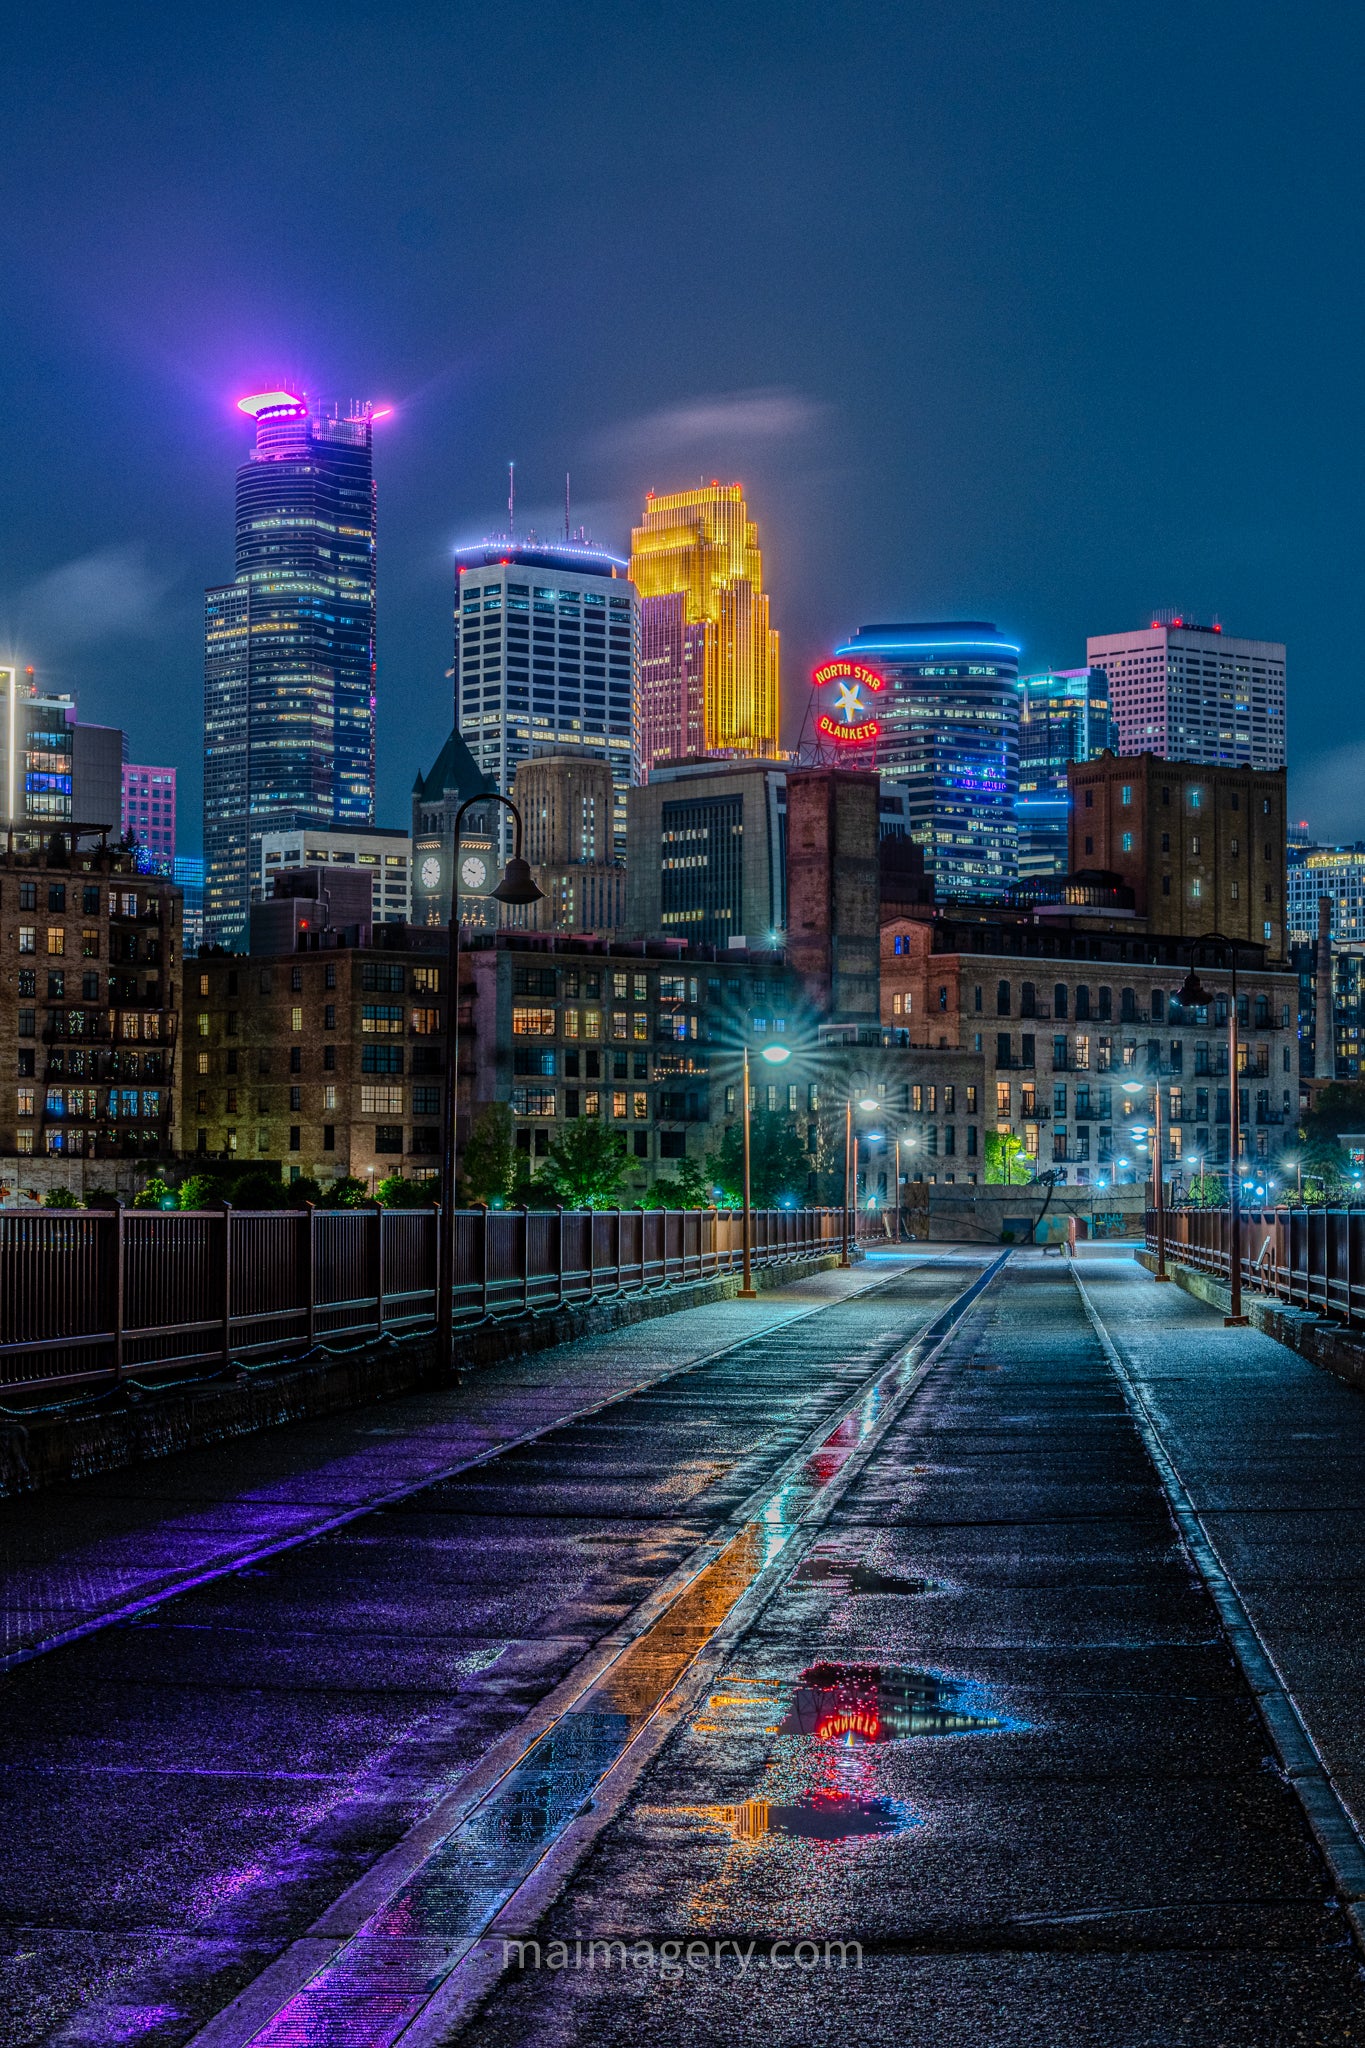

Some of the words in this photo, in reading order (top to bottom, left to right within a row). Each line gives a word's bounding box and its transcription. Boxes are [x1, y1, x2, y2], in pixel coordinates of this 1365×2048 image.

[816, 664, 851, 684] NORTH
[854, 666, 880, 690] STAR
[821, 717, 877, 739] BLANKETS
